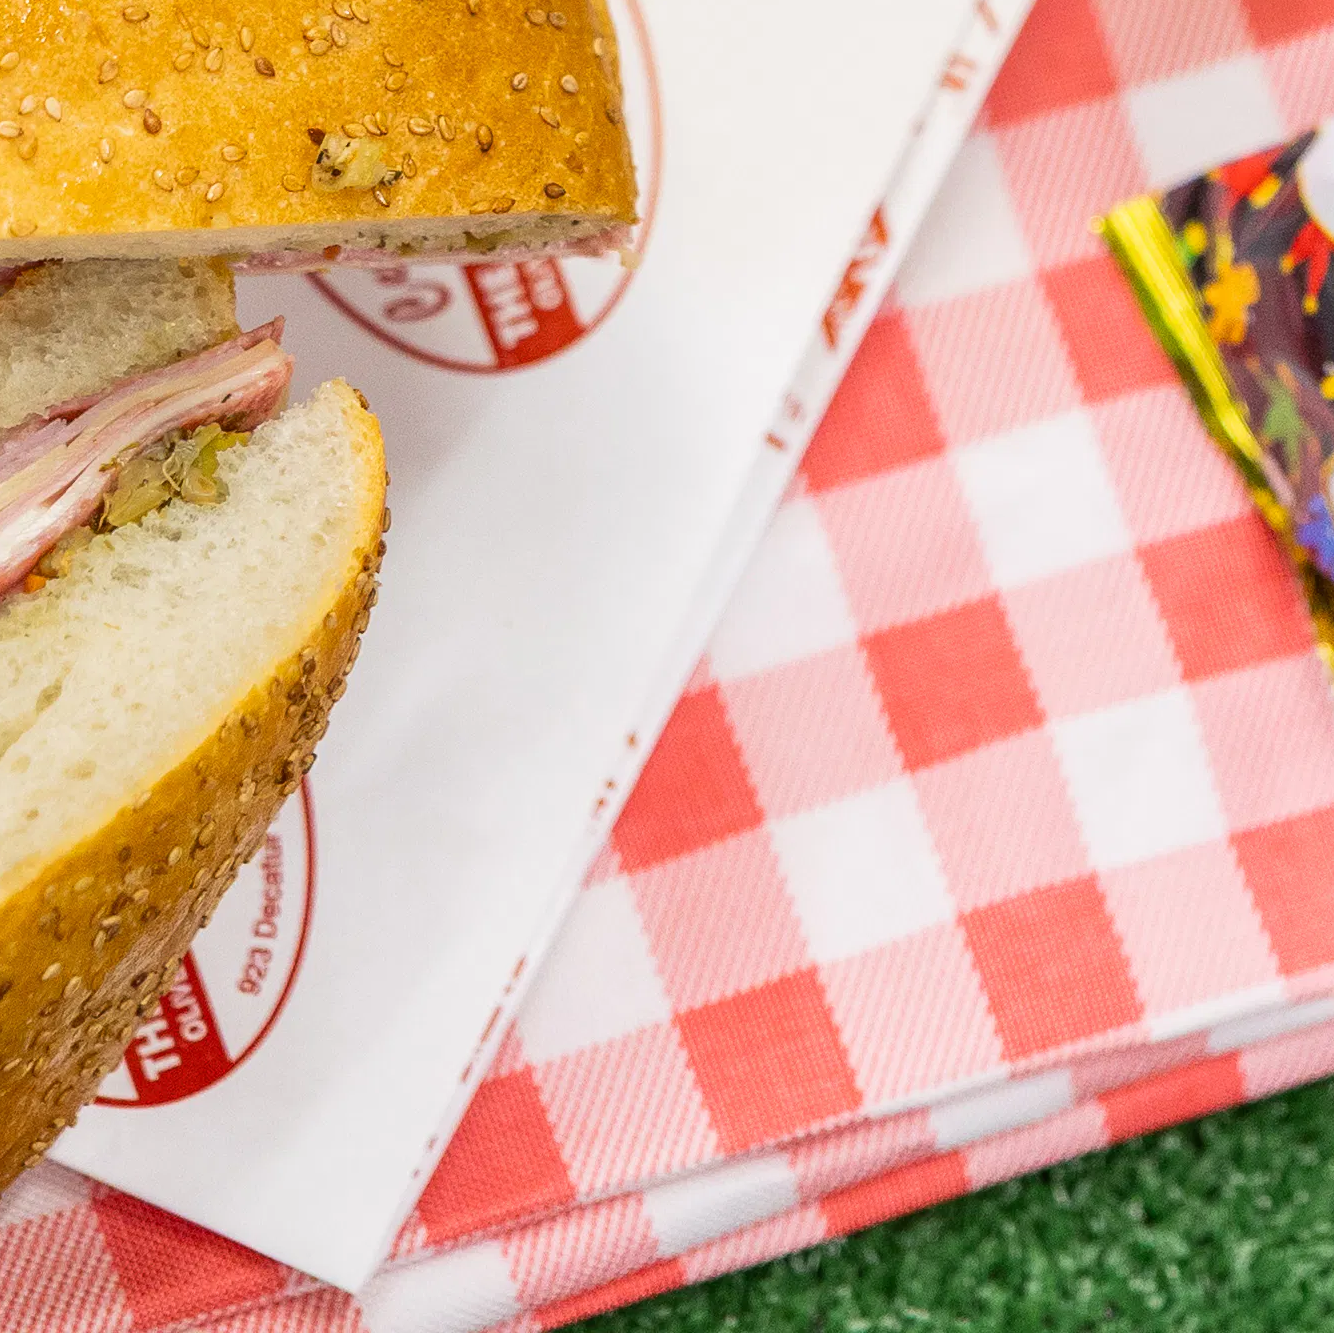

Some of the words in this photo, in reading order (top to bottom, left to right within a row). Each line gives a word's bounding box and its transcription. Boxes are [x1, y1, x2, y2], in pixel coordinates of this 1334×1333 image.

[254, 832, 286, 940] Decatur
[236, 946, 273, 997] 923
[136, 999, 182, 1083] TH
